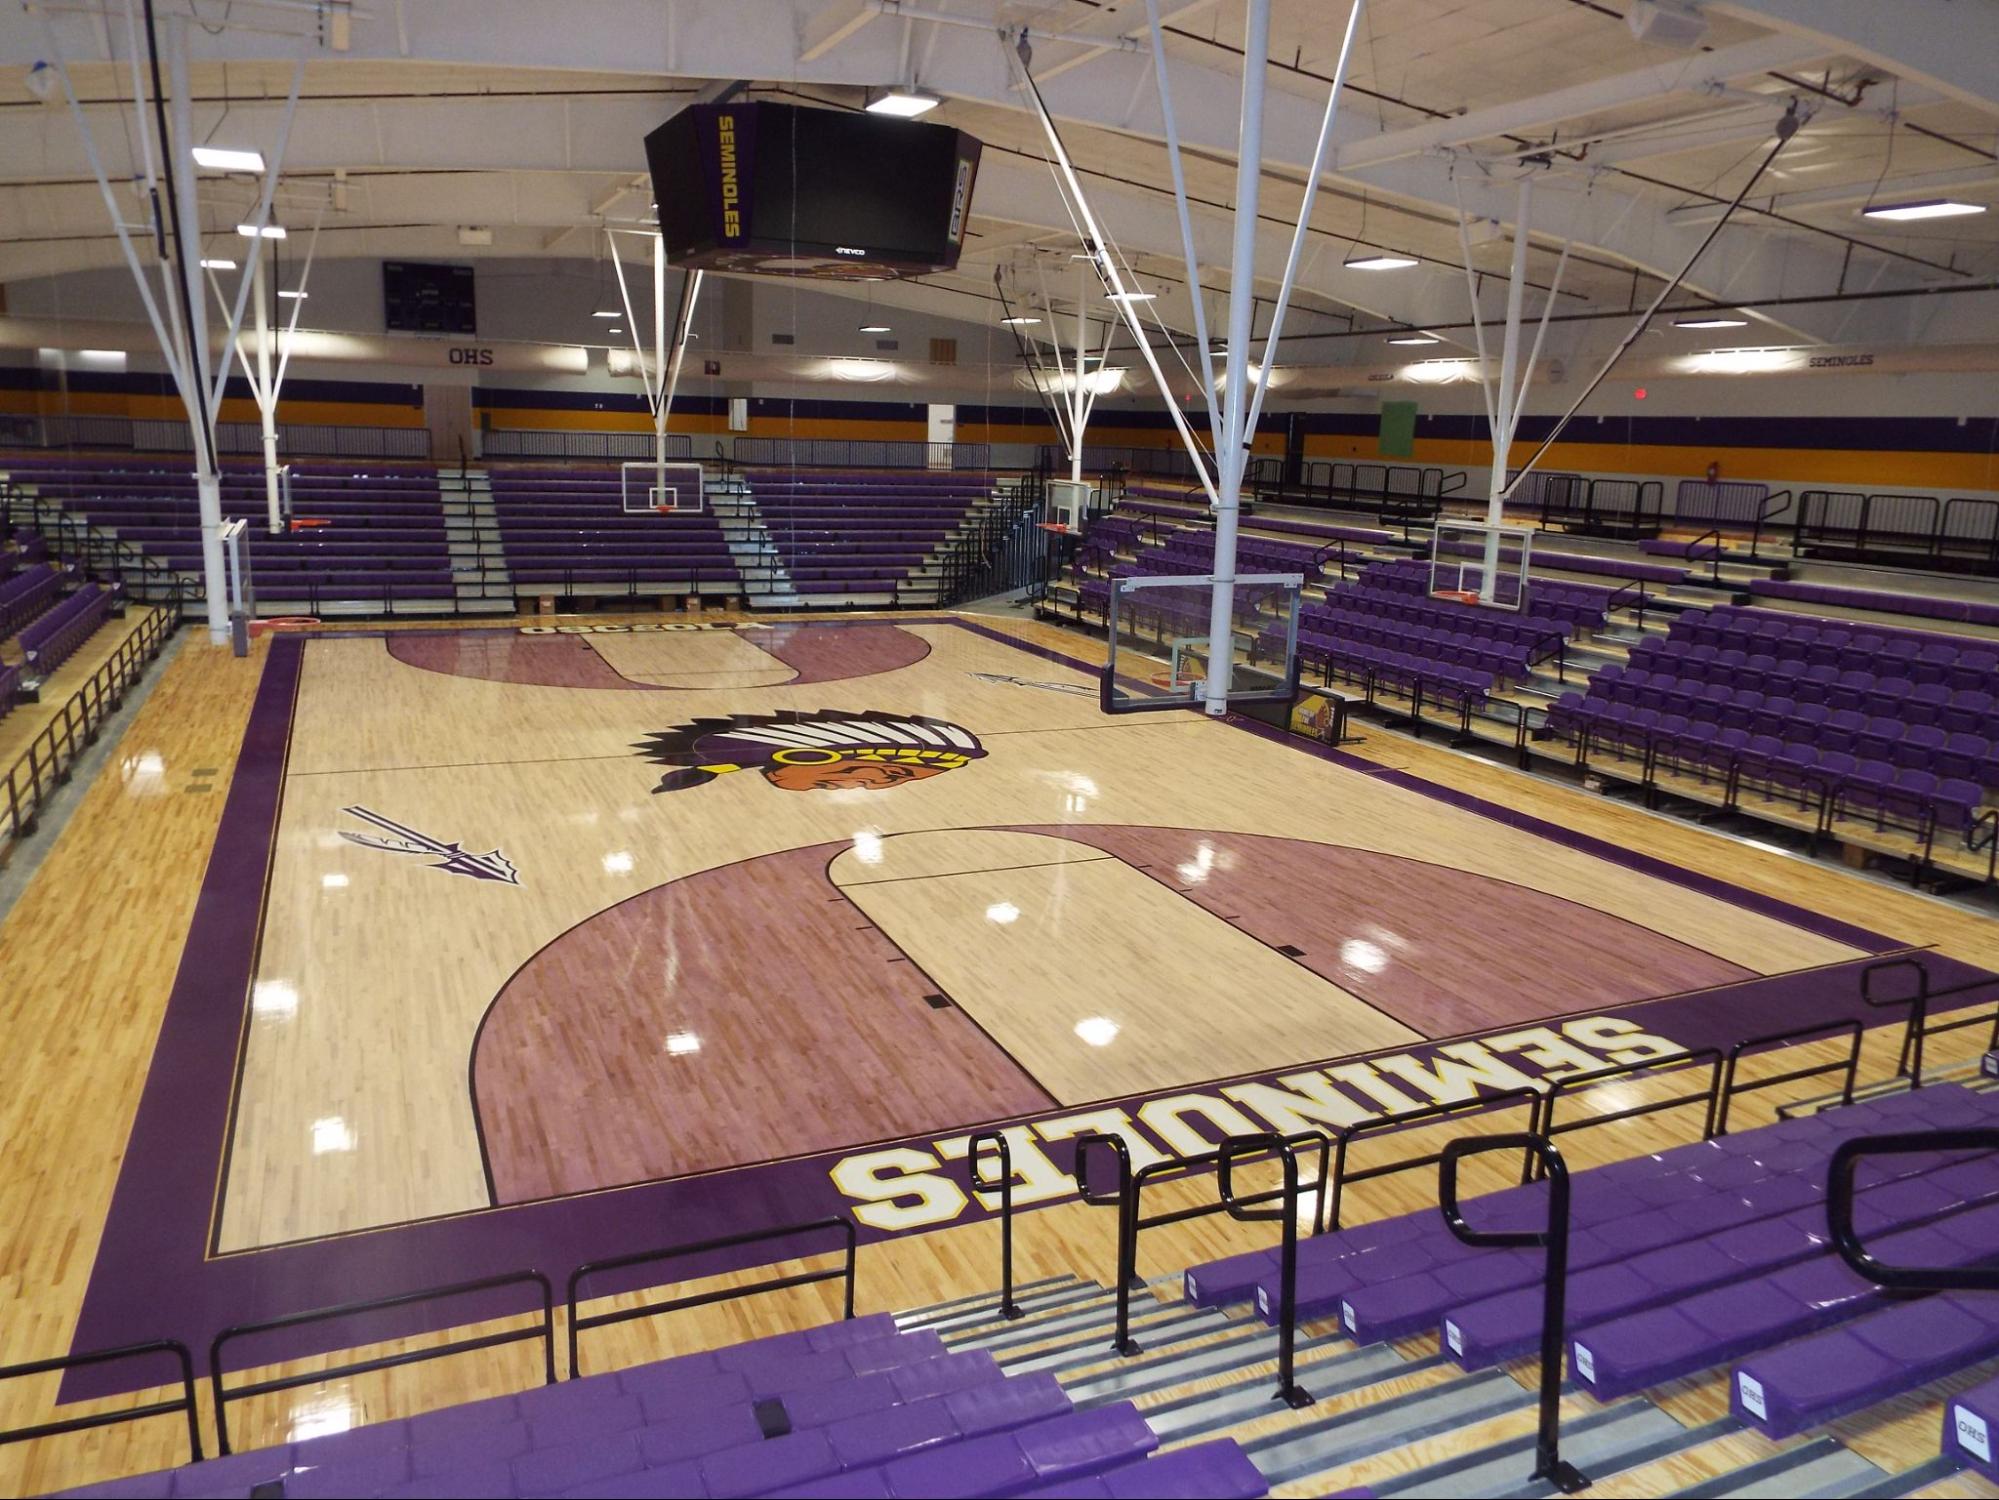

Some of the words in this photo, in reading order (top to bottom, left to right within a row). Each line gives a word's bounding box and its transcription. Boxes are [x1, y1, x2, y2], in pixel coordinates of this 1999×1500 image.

[719, 116, 740, 237] SEMINOLES
[449, 348, 494, 366] OHS
[829, 1016, 1692, 1231] SEMINOLES
[1742, 1384, 1763, 1405] OHS
[1958, 1420, 1986, 1444] OHS
